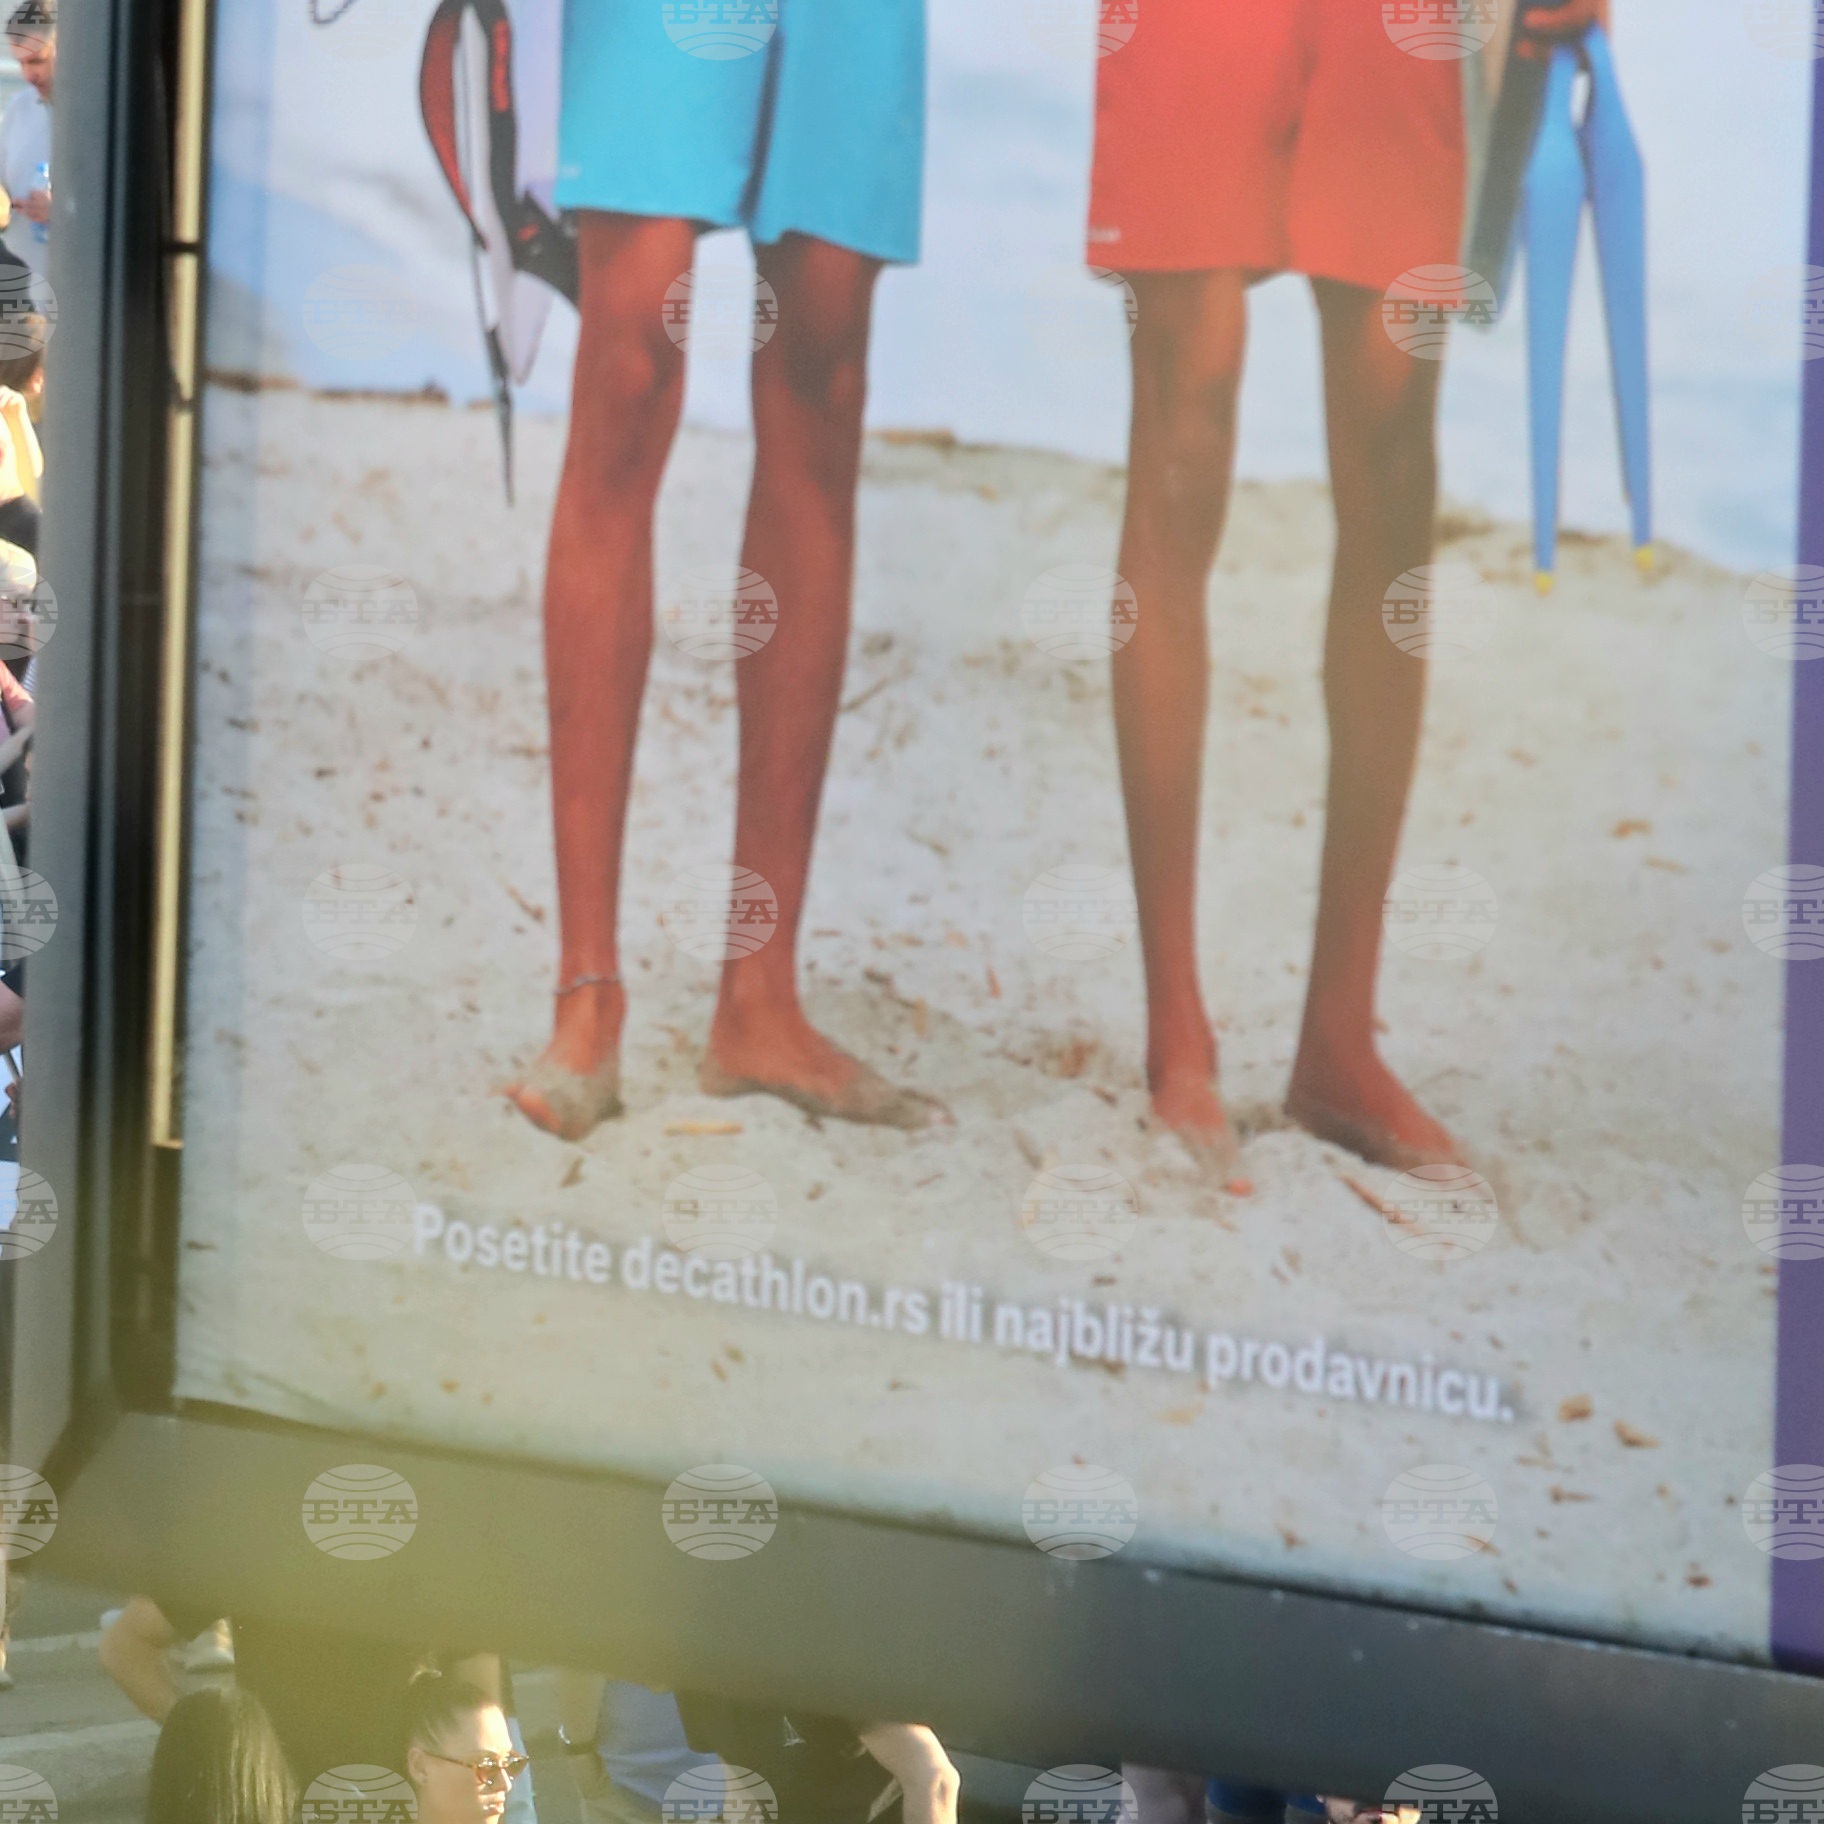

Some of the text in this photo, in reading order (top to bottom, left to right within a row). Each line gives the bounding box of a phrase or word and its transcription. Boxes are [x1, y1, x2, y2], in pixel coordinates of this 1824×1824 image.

[413, 1203, 1514, 1422] Posetite decathlon.rs ili najbližu prodavnicu.
